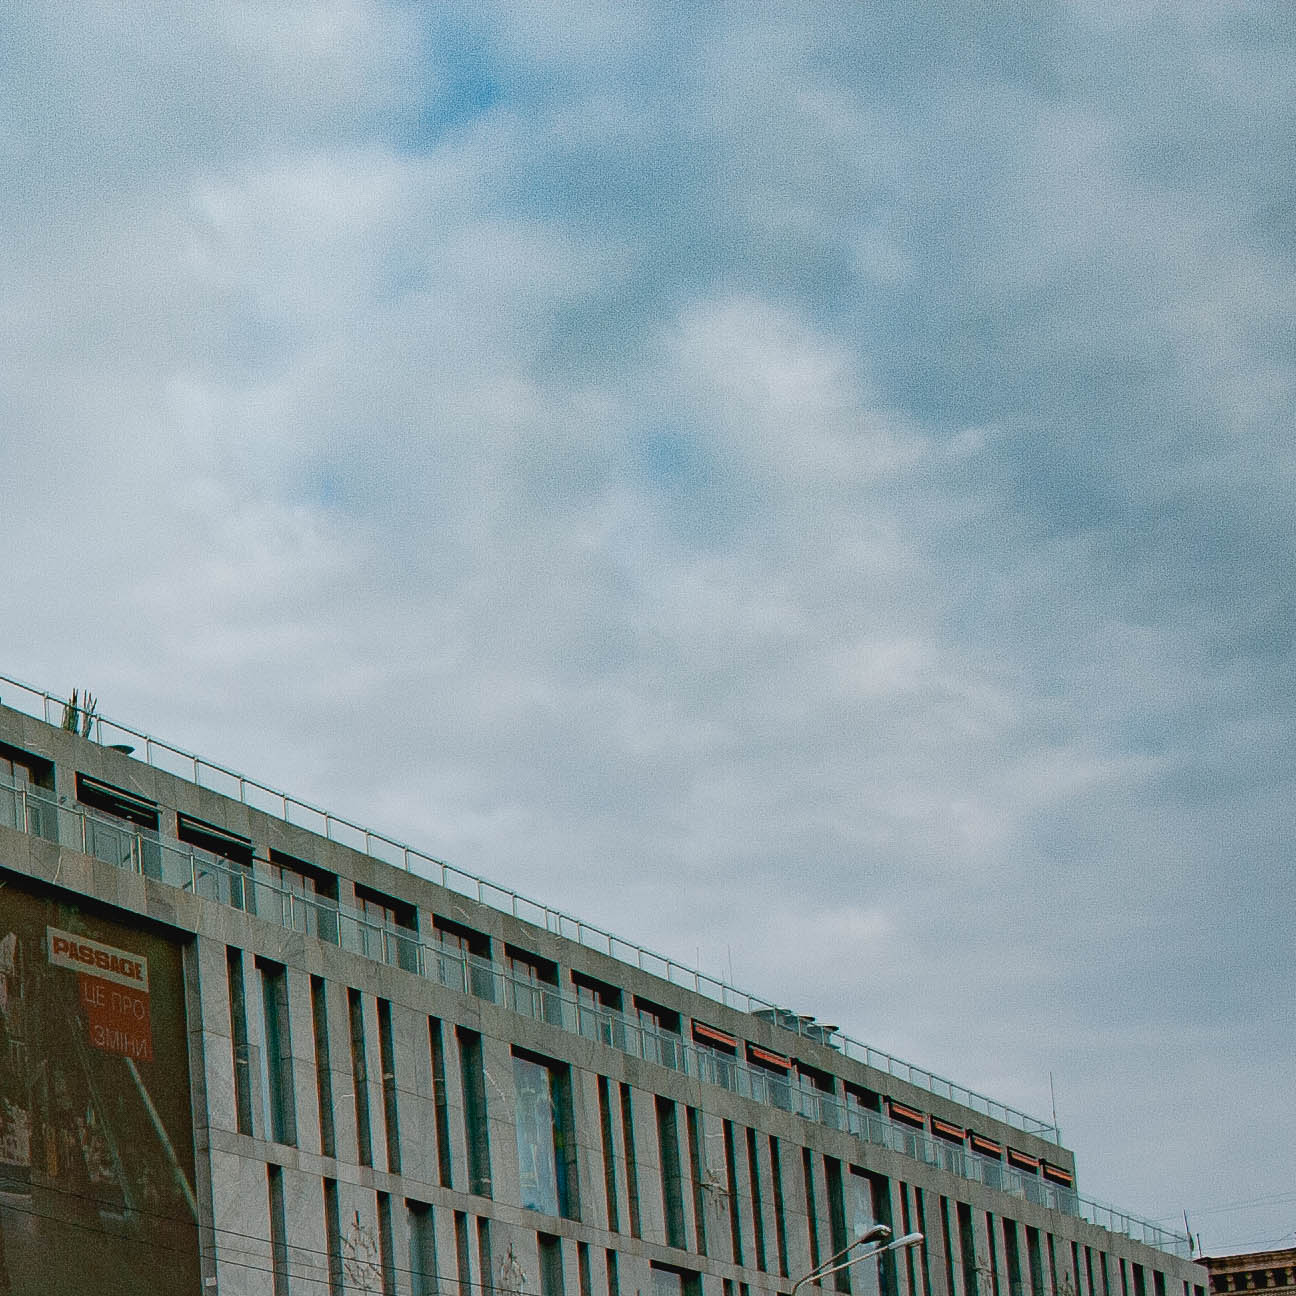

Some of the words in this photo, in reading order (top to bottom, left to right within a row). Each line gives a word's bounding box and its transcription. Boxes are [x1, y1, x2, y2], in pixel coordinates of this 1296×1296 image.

[53, 936, 144, 981] PASSAGE
[83, 984, 105, 1009] ЦЕ
[112, 992, 145, 1020] ПРО
